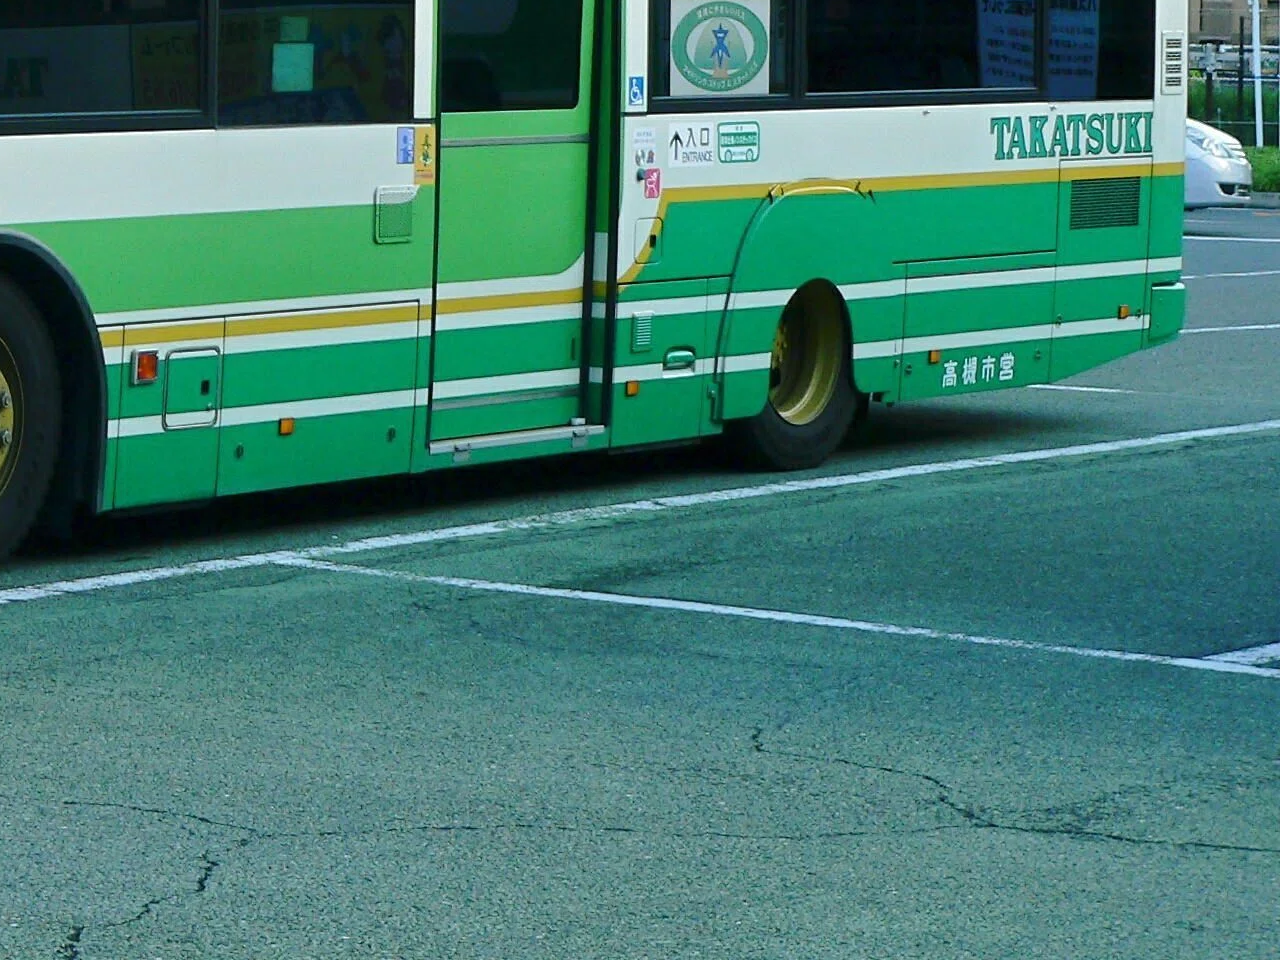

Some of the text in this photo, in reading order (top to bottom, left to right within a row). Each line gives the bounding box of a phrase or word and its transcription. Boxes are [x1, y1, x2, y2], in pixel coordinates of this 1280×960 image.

[686, 127, 710, 147] 入口
[990, 112, 1154, 160] TAKATSUKI
[682, 150, 713, 163] ENTRANCE
[942, 352, 1015, 388] 高槻市営
